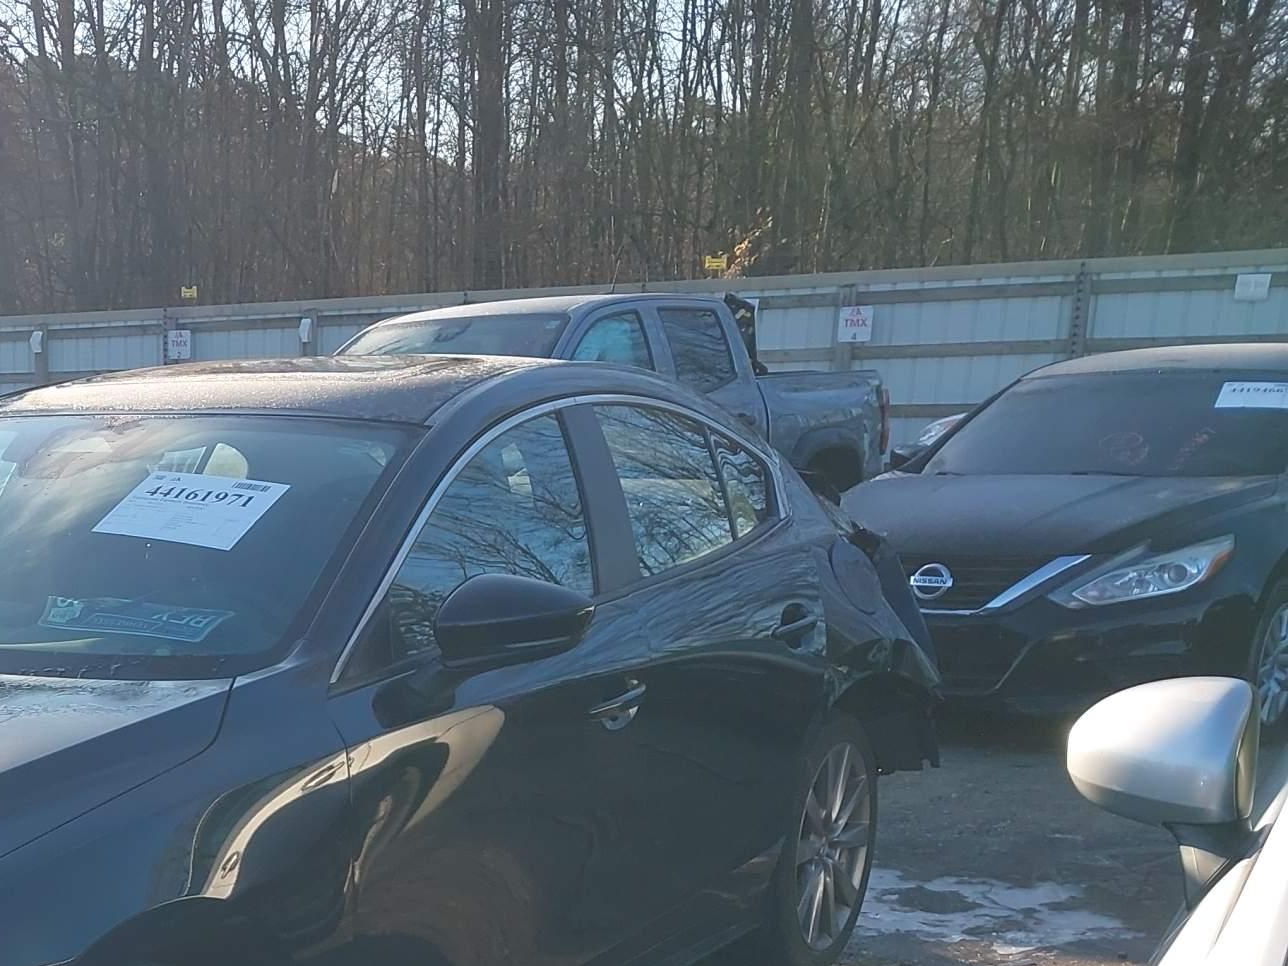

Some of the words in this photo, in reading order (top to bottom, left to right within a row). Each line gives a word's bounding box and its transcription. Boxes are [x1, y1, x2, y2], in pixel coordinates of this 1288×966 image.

[844, 318, 868, 328] TMX
[146, 485, 255, 508] 44161971
[913, 577, 947, 585] NISSAN
